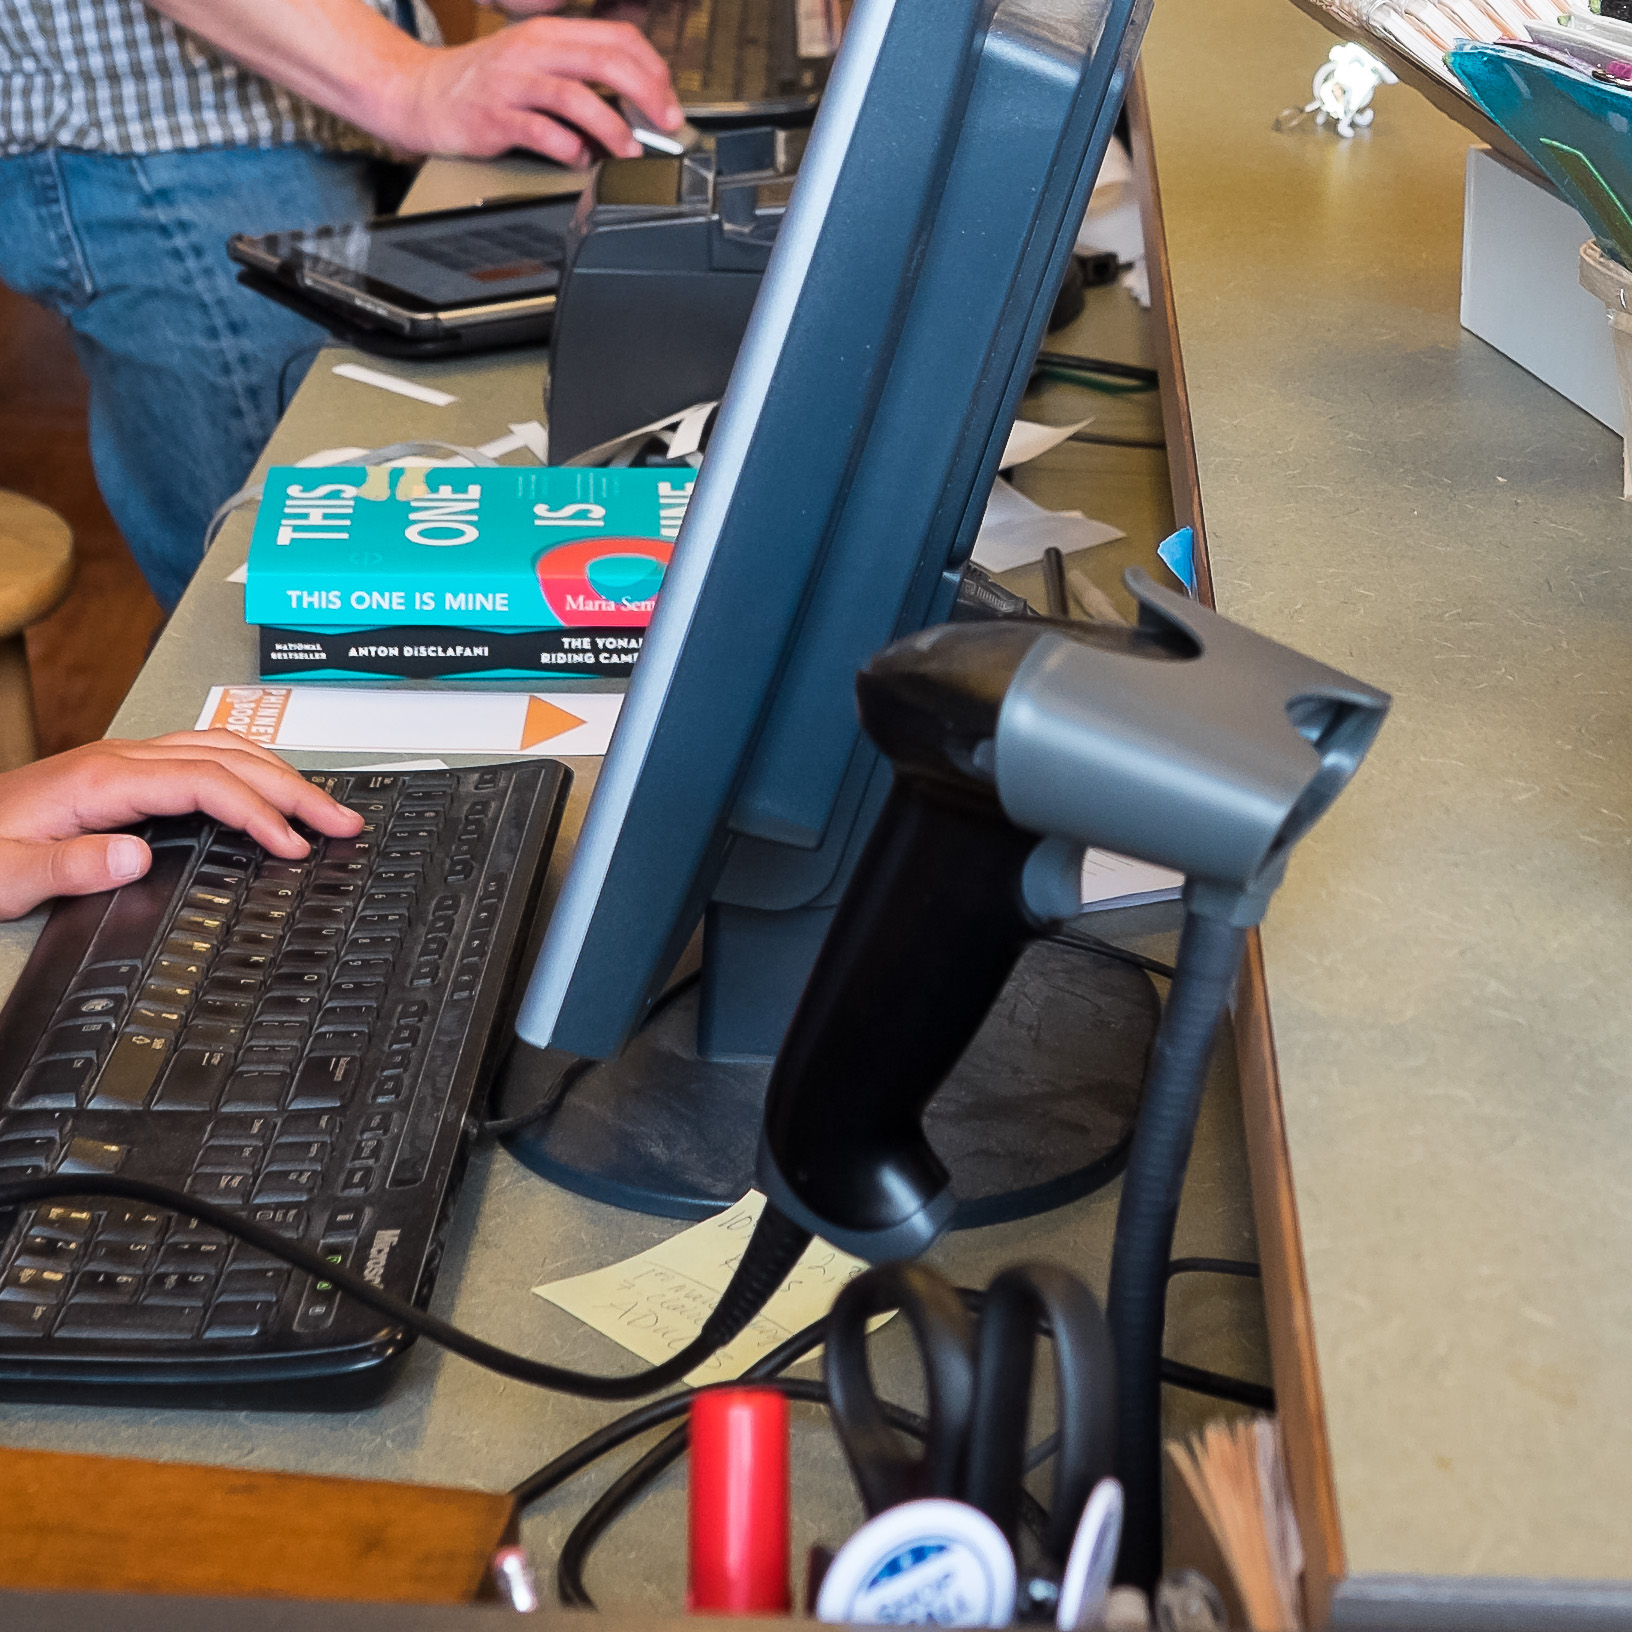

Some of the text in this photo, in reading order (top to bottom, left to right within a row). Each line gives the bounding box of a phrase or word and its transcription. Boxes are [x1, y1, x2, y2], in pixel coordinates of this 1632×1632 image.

[277, 483, 357, 545] THIS
[405, 483, 481, 546] ONE
[533, 502, 607, 527] IS
[287, 590, 509, 612] THIS ONE IS MINE
[565, 594, 655, 612] Maria Sem
[275, 643, 322, 651] NATIONAL
[348, 646, 489, 657] ANTON DISCLAFANI
[561, 637, 591, 649] THE
[271, 651, 327, 660] BESTSELLER
[540, 652, 595, 664] RIDING
[225, 702, 257, 739] BOOK
[249, 688, 287, 743] PHINNEY
